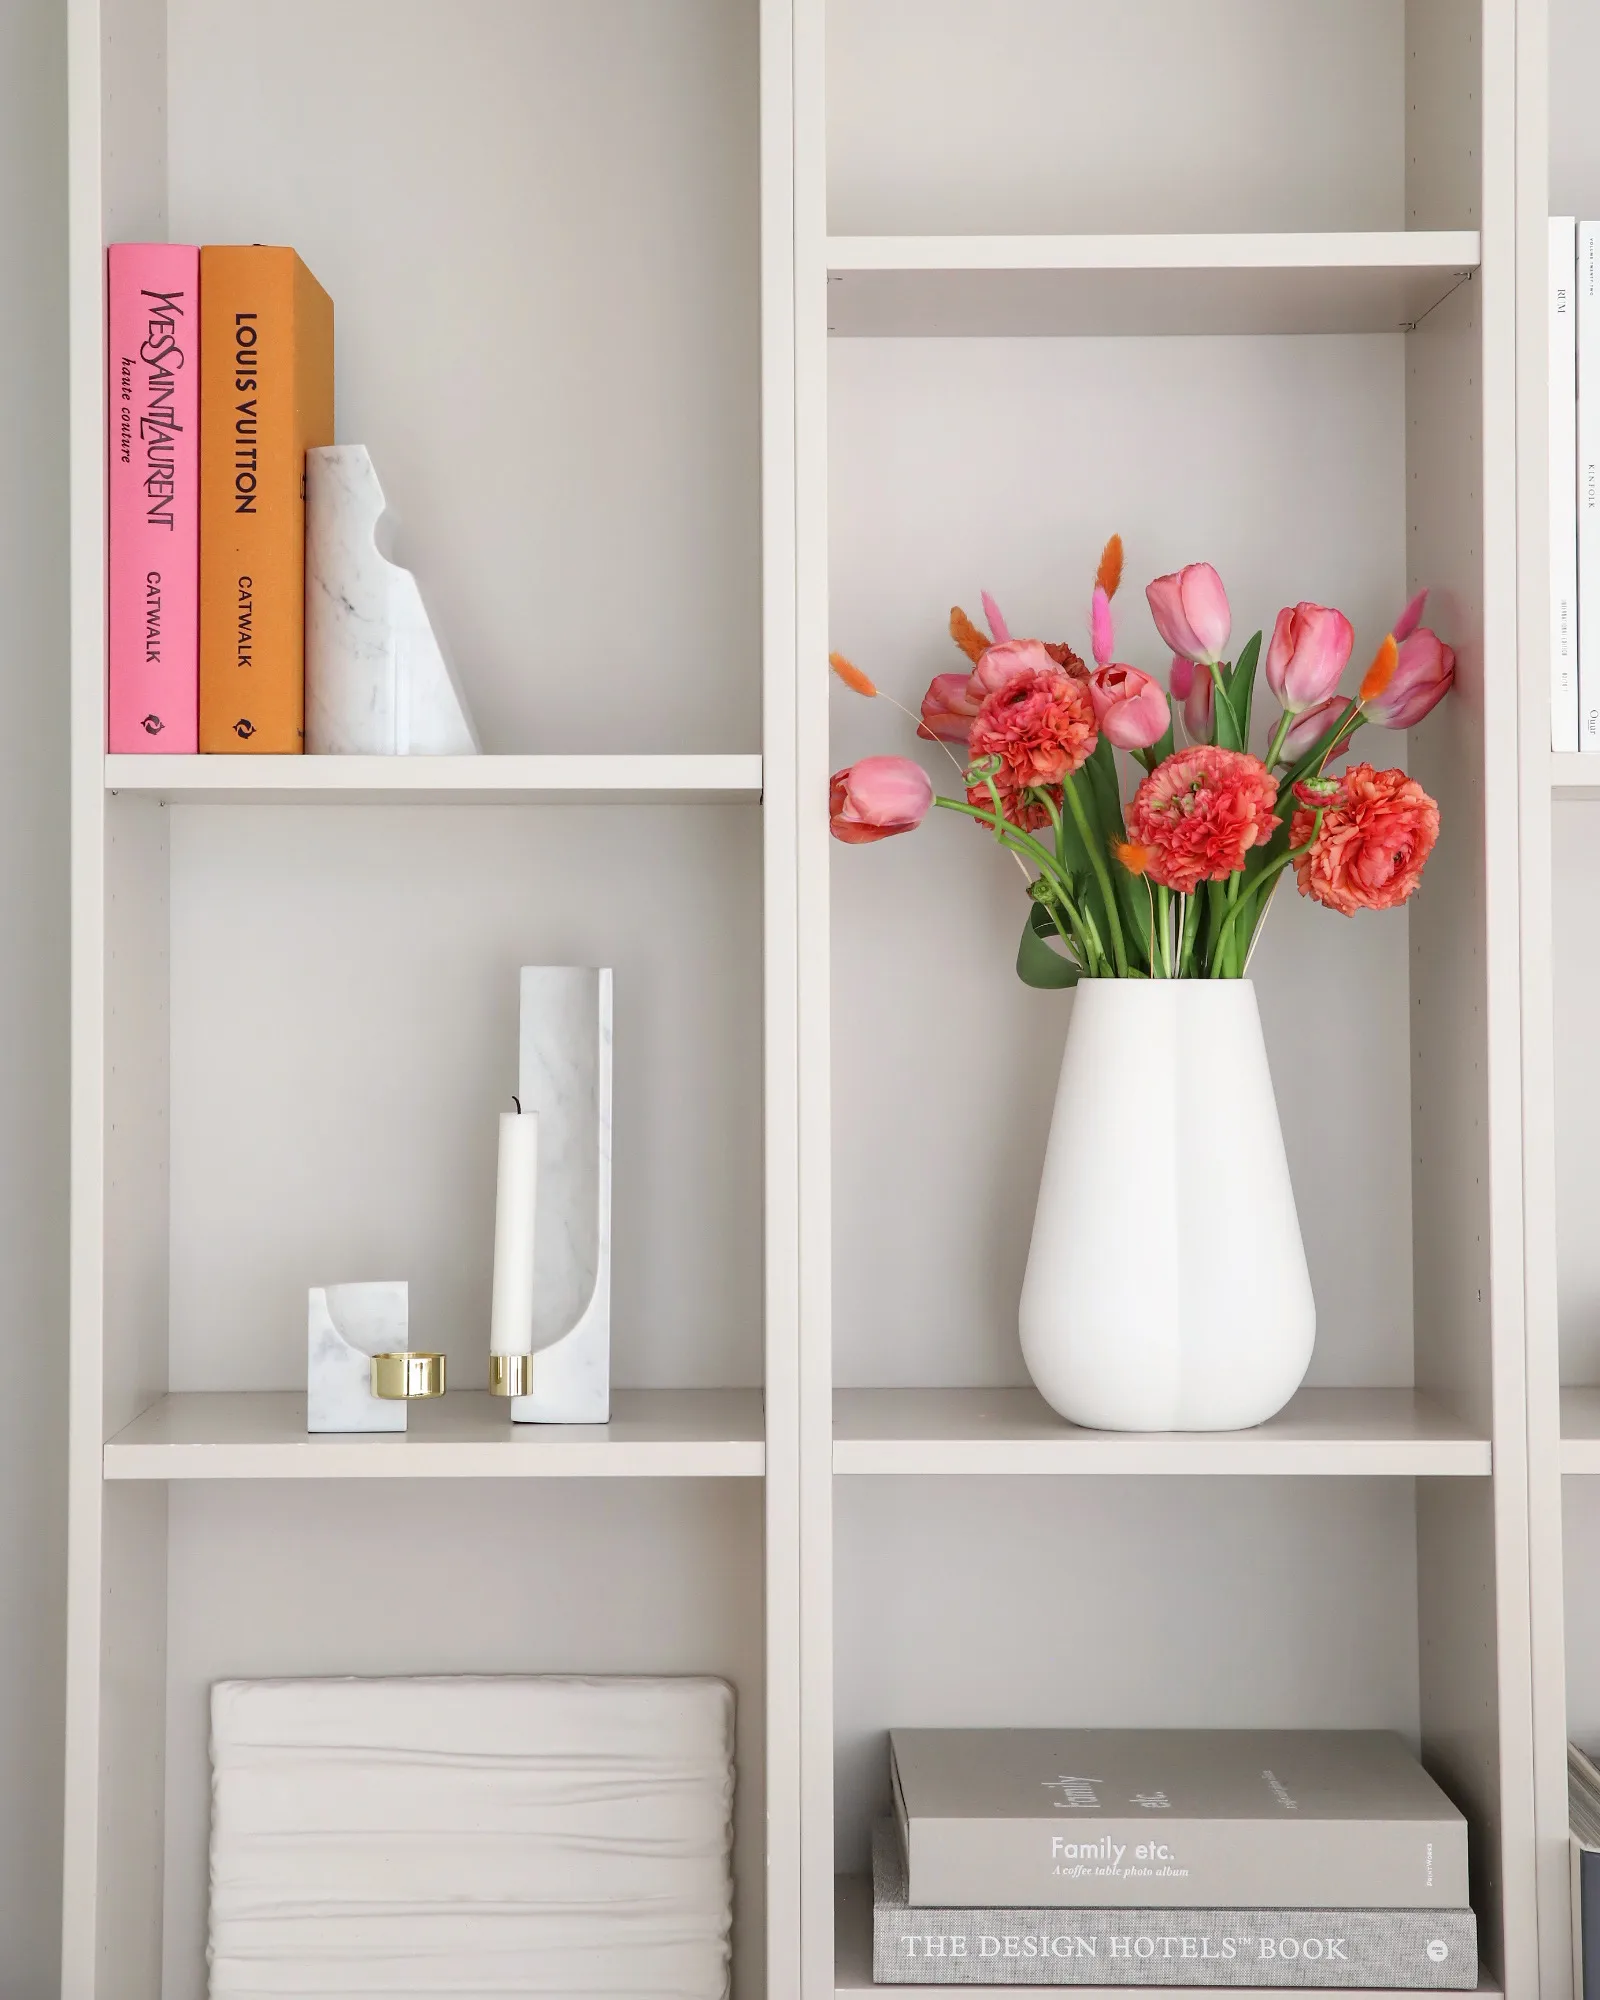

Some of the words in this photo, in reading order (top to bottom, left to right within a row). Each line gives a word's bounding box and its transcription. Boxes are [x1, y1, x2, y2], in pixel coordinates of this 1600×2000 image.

[1557, 288, 1566, 314] RUM
[235, 313, 258, 392] LOUIS
[121, 357, 136, 401] haute
[121, 407, 134, 463] couture
[235, 399, 257, 514] VUITTON
[146, 571, 161, 664] CATWALK
[238, 575, 253, 668] CATWALK
[1041, 1775, 1103, 1808] Family
[1051, 1835, 1127, 1866] Family
[1135, 1840, 1175, 1861] etc.
[1052, 1865, 1061, 1875] A
[1063, 1865, 1092, 1878] coffee
[1095, 1864, 1121, 1876] table
[1123, 1865, 1153, 1879] photo
[1156, 1866, 1189, 1877] album
[901, 1935, 968, 1958] THE
[979, 1935, 1098, 1958] DESIGN
[1259, 1937, 1350, 1960] BOOK
